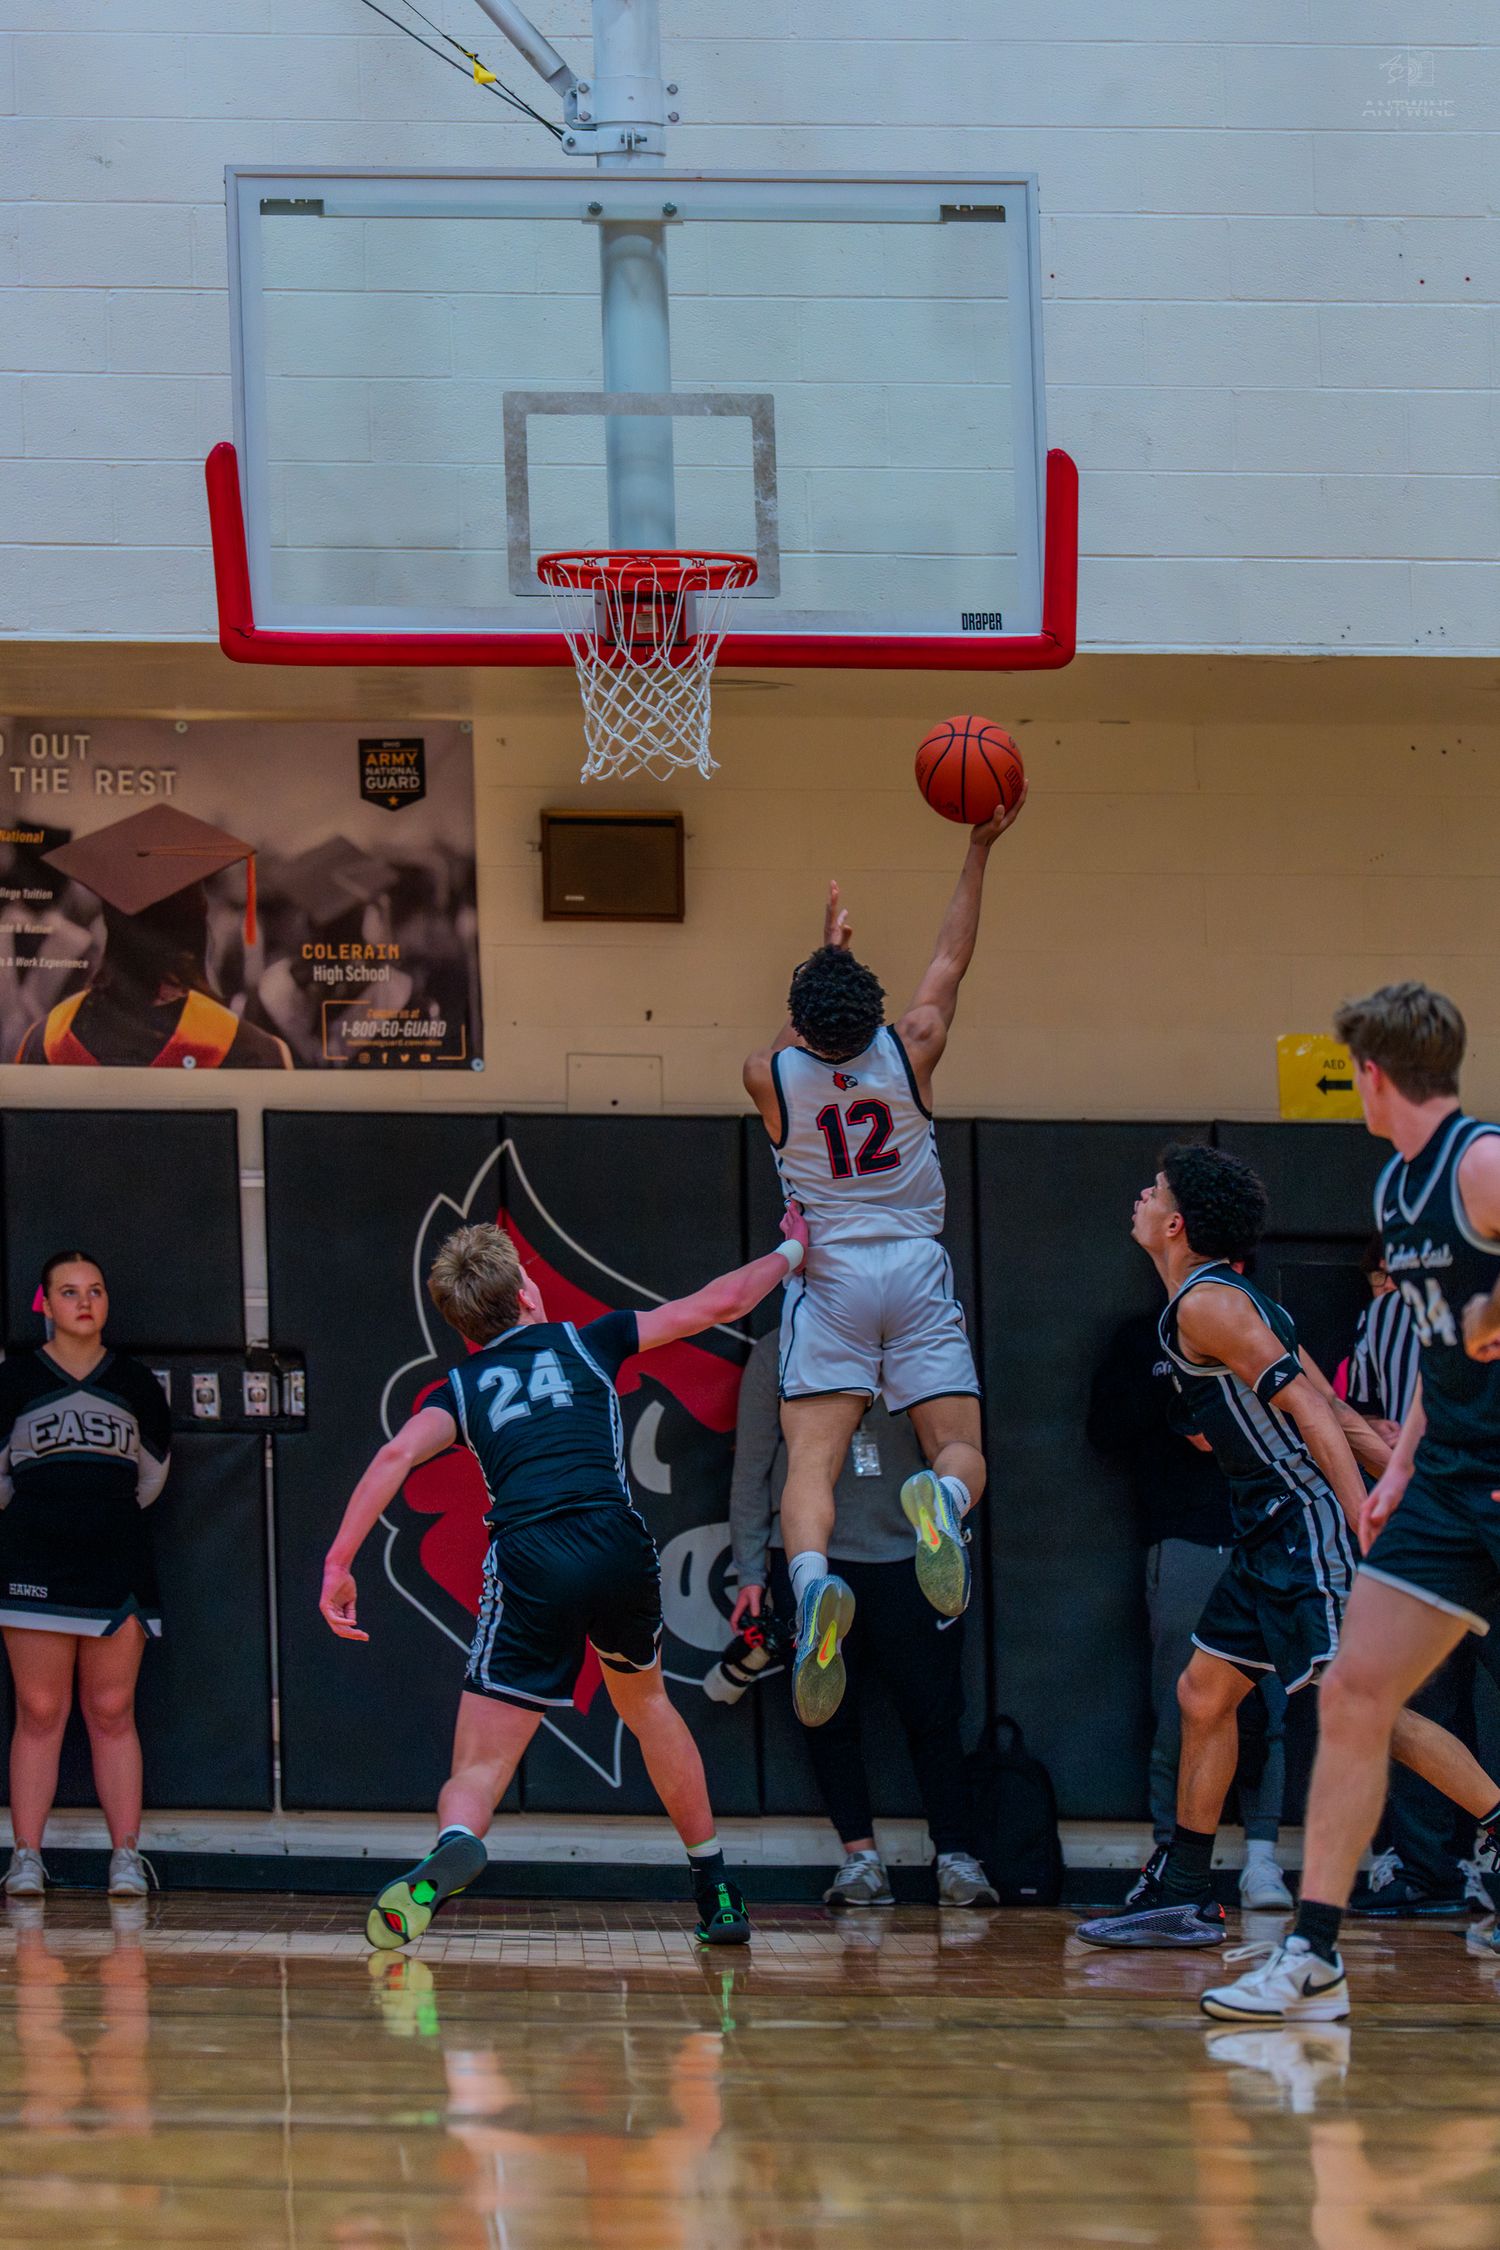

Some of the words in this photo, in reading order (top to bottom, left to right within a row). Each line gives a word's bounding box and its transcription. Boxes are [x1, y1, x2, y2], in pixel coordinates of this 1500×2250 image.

[30, 733, 91, 760] OUT
[365, 752, 418, 767] ARMY
[365, 767, 419, 776] NATIONAL
[9, 767, 70, 793] THE
[95, 769, 177, 796] REST
[365, 776, 420, 790] GUARD
[302, 944, 400, 960] COLERAIN
[313, 965, 344, 986] High
[345, 964, 390, 982] School
[341, 1020, 447, 1038] 1-800-GO-GUARD
[1323, 1059, 1346, 1071] AED
[816, 1098, 902, 1180] 12
[476, 1348, 575, 1433] 24
[28, 1410, 135, 1453] EAST
[9, 1583, 49, 1599] HAWKS
